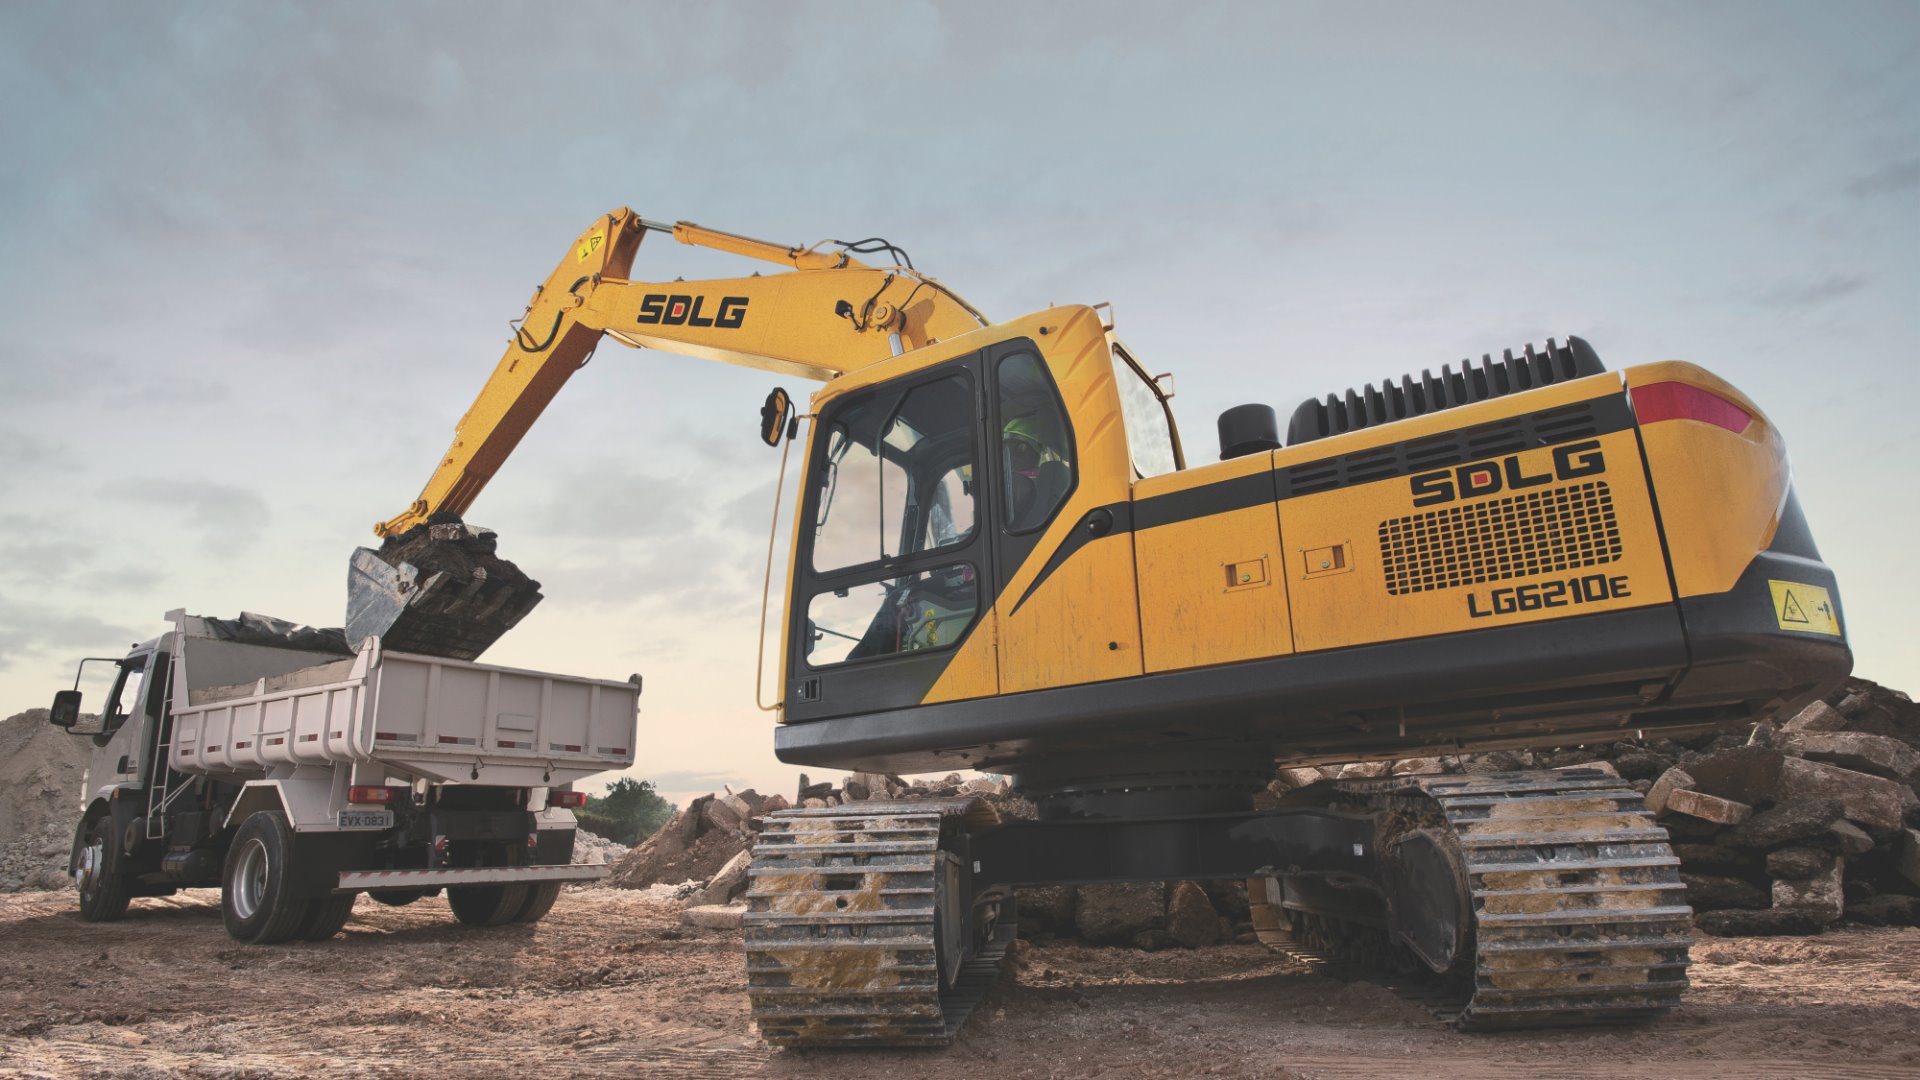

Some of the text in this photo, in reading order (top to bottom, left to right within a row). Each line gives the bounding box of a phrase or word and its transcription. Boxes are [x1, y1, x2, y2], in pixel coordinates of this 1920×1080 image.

[637, 294, 749, 328] SDLG
[1410, 440, 1606, 508] SDLG
[1467, 573, 1632, 618] LG6210E
